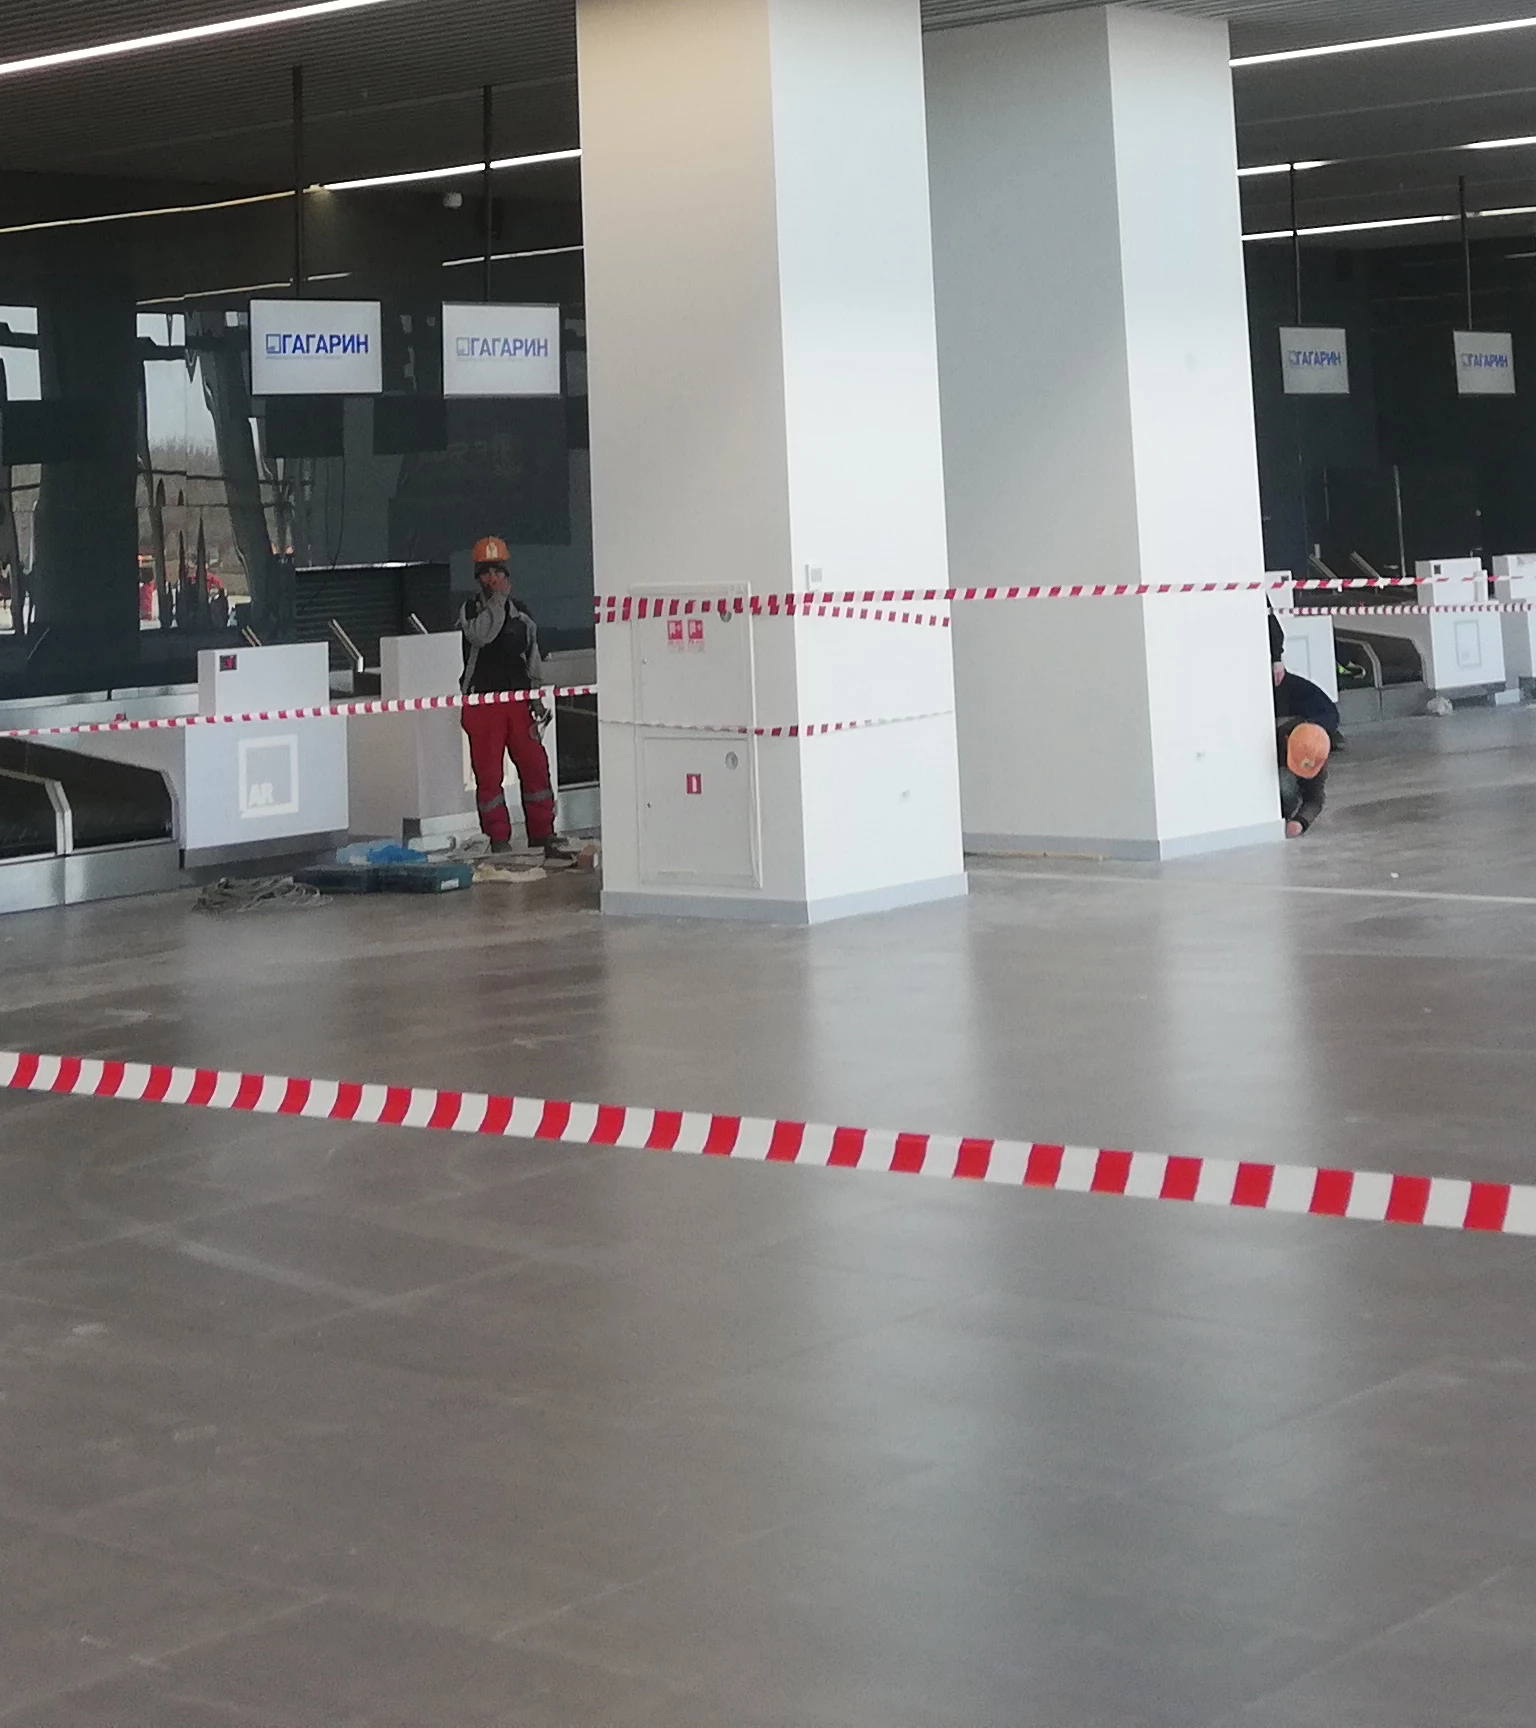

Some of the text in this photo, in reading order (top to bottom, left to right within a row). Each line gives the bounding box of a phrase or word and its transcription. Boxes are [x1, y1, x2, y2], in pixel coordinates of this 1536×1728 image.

[283, 334, 369, 354] ГАГАРИН
[471, 337, 549, 357] ГАГАРИН
[1296, 350, 1342, 366] ГАГАРИН
[1468, 353, 1508, 368] ГАГАРИН
